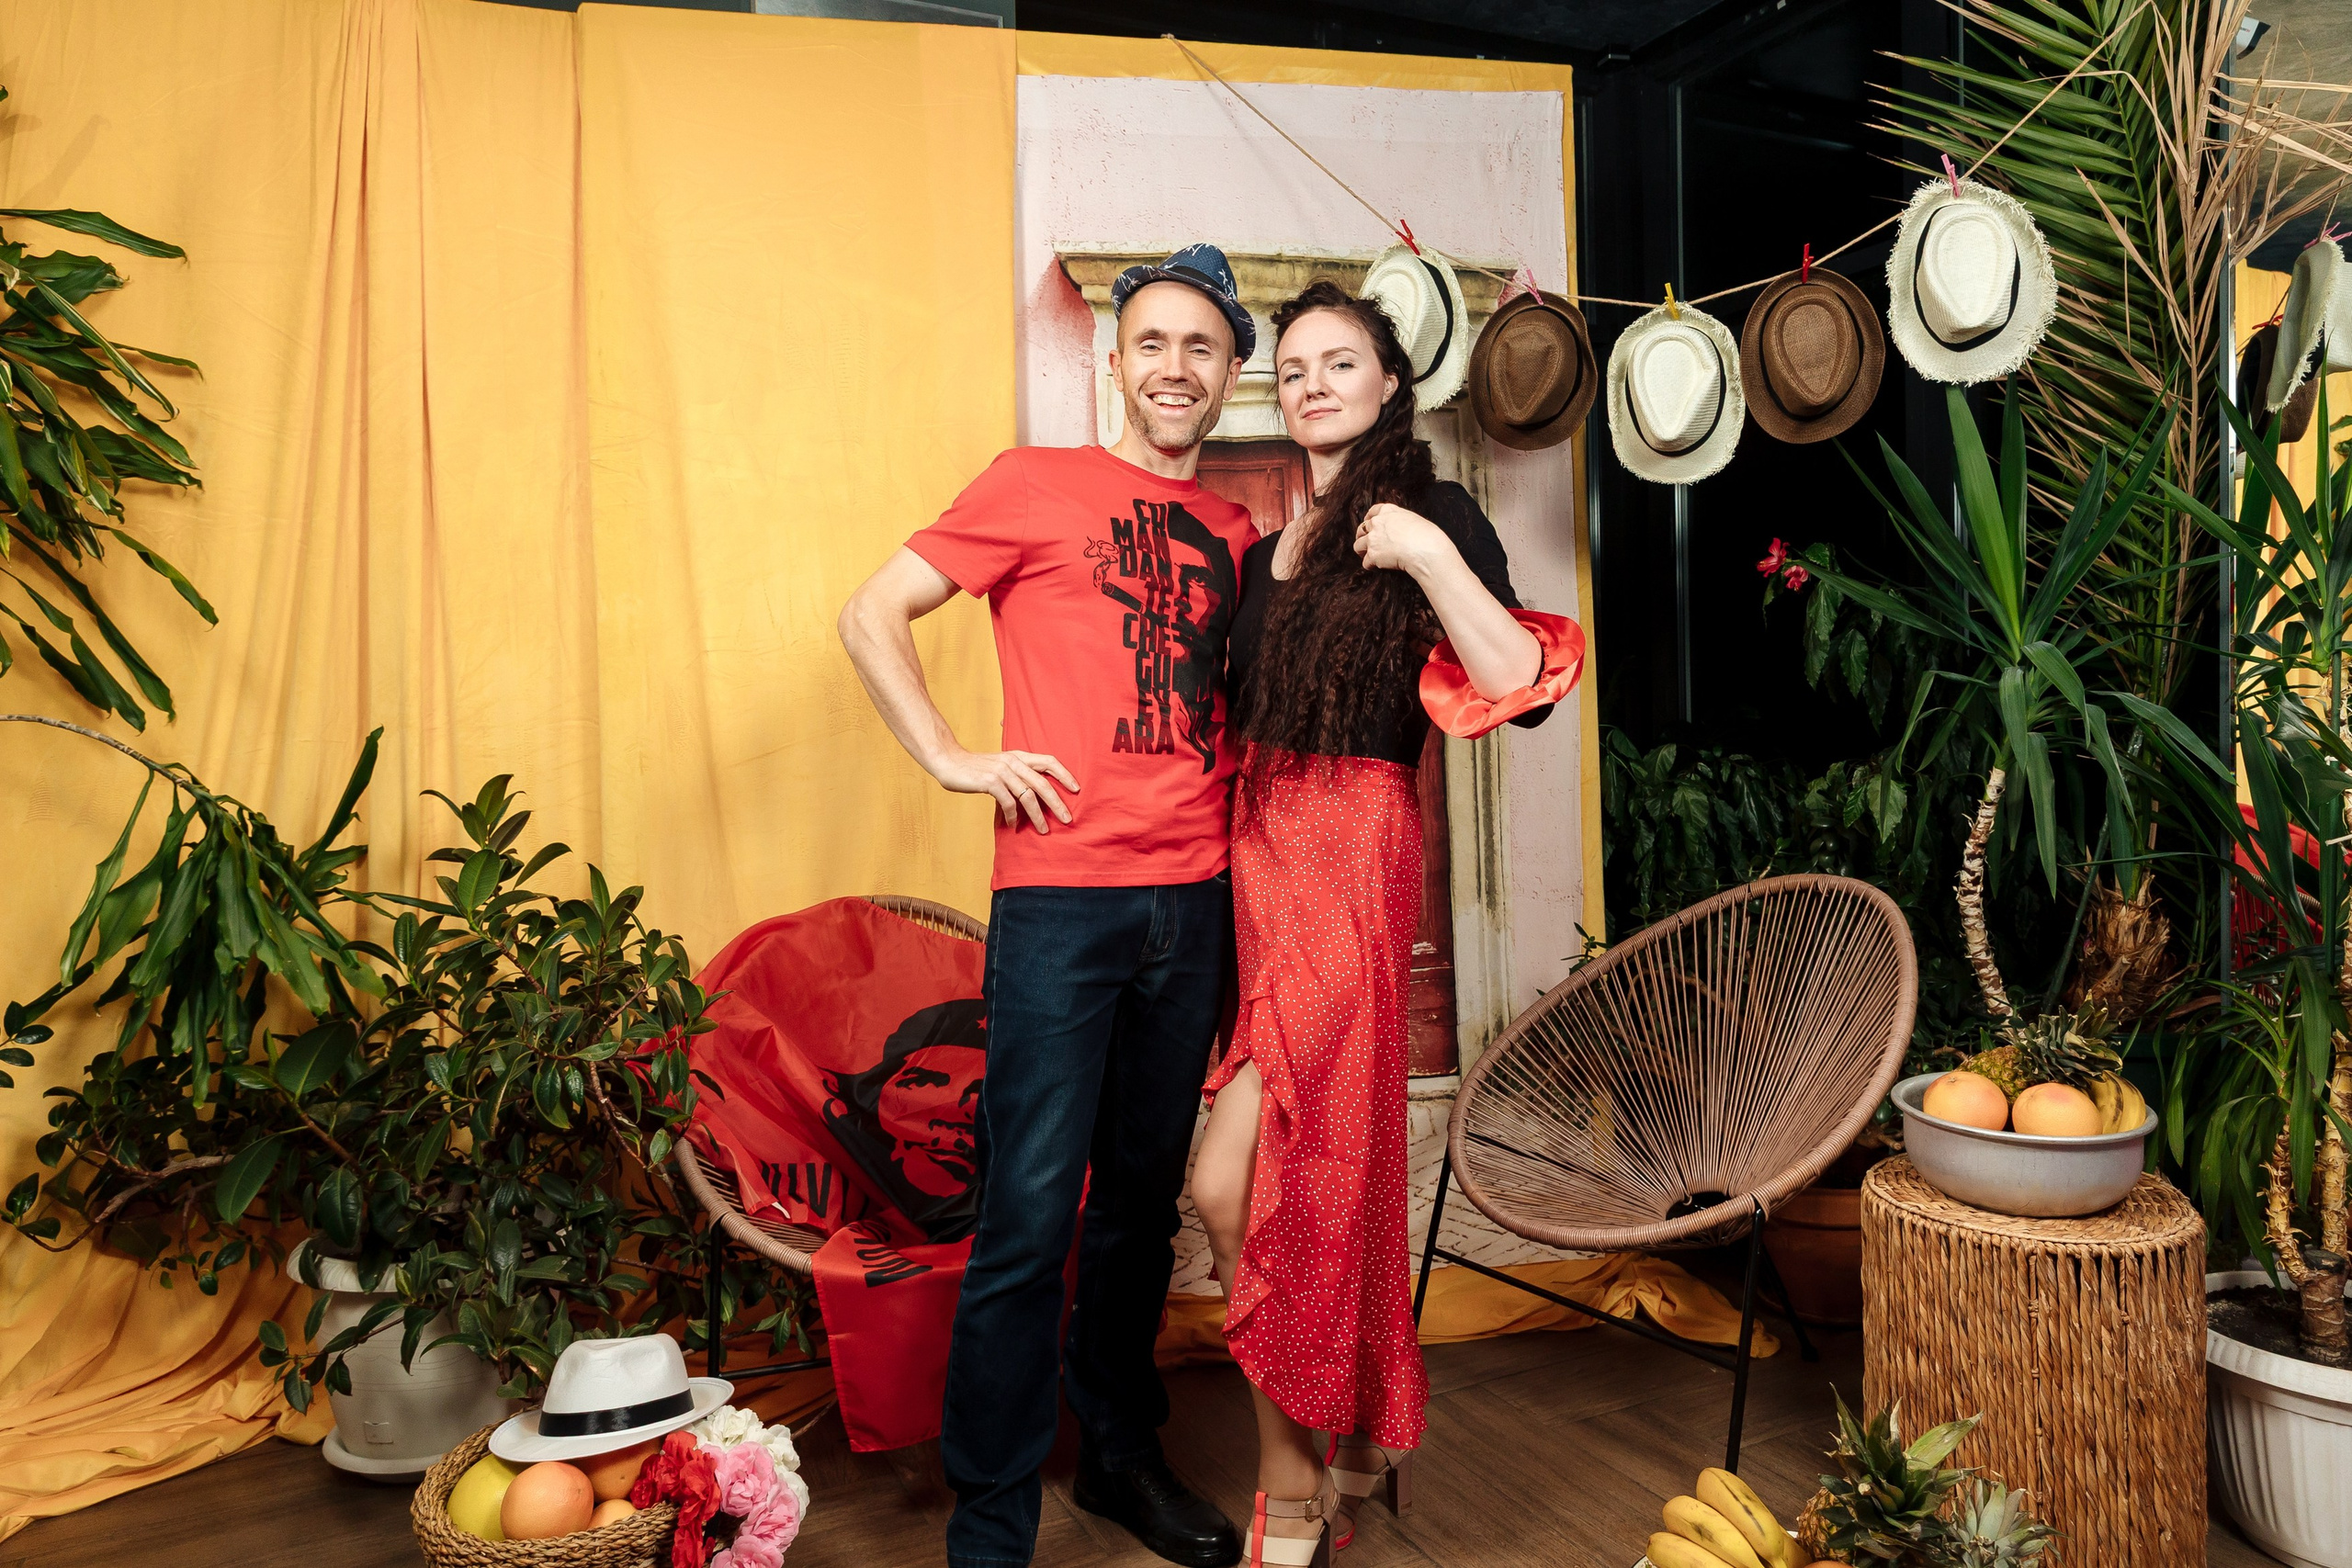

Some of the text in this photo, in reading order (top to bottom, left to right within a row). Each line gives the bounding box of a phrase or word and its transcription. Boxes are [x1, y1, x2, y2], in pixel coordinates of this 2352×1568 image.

[1123, 613, 1171, 656] CHE
[1136, 649, 1171, 691] GU
[1112, 717, 1175, 755] ARA
